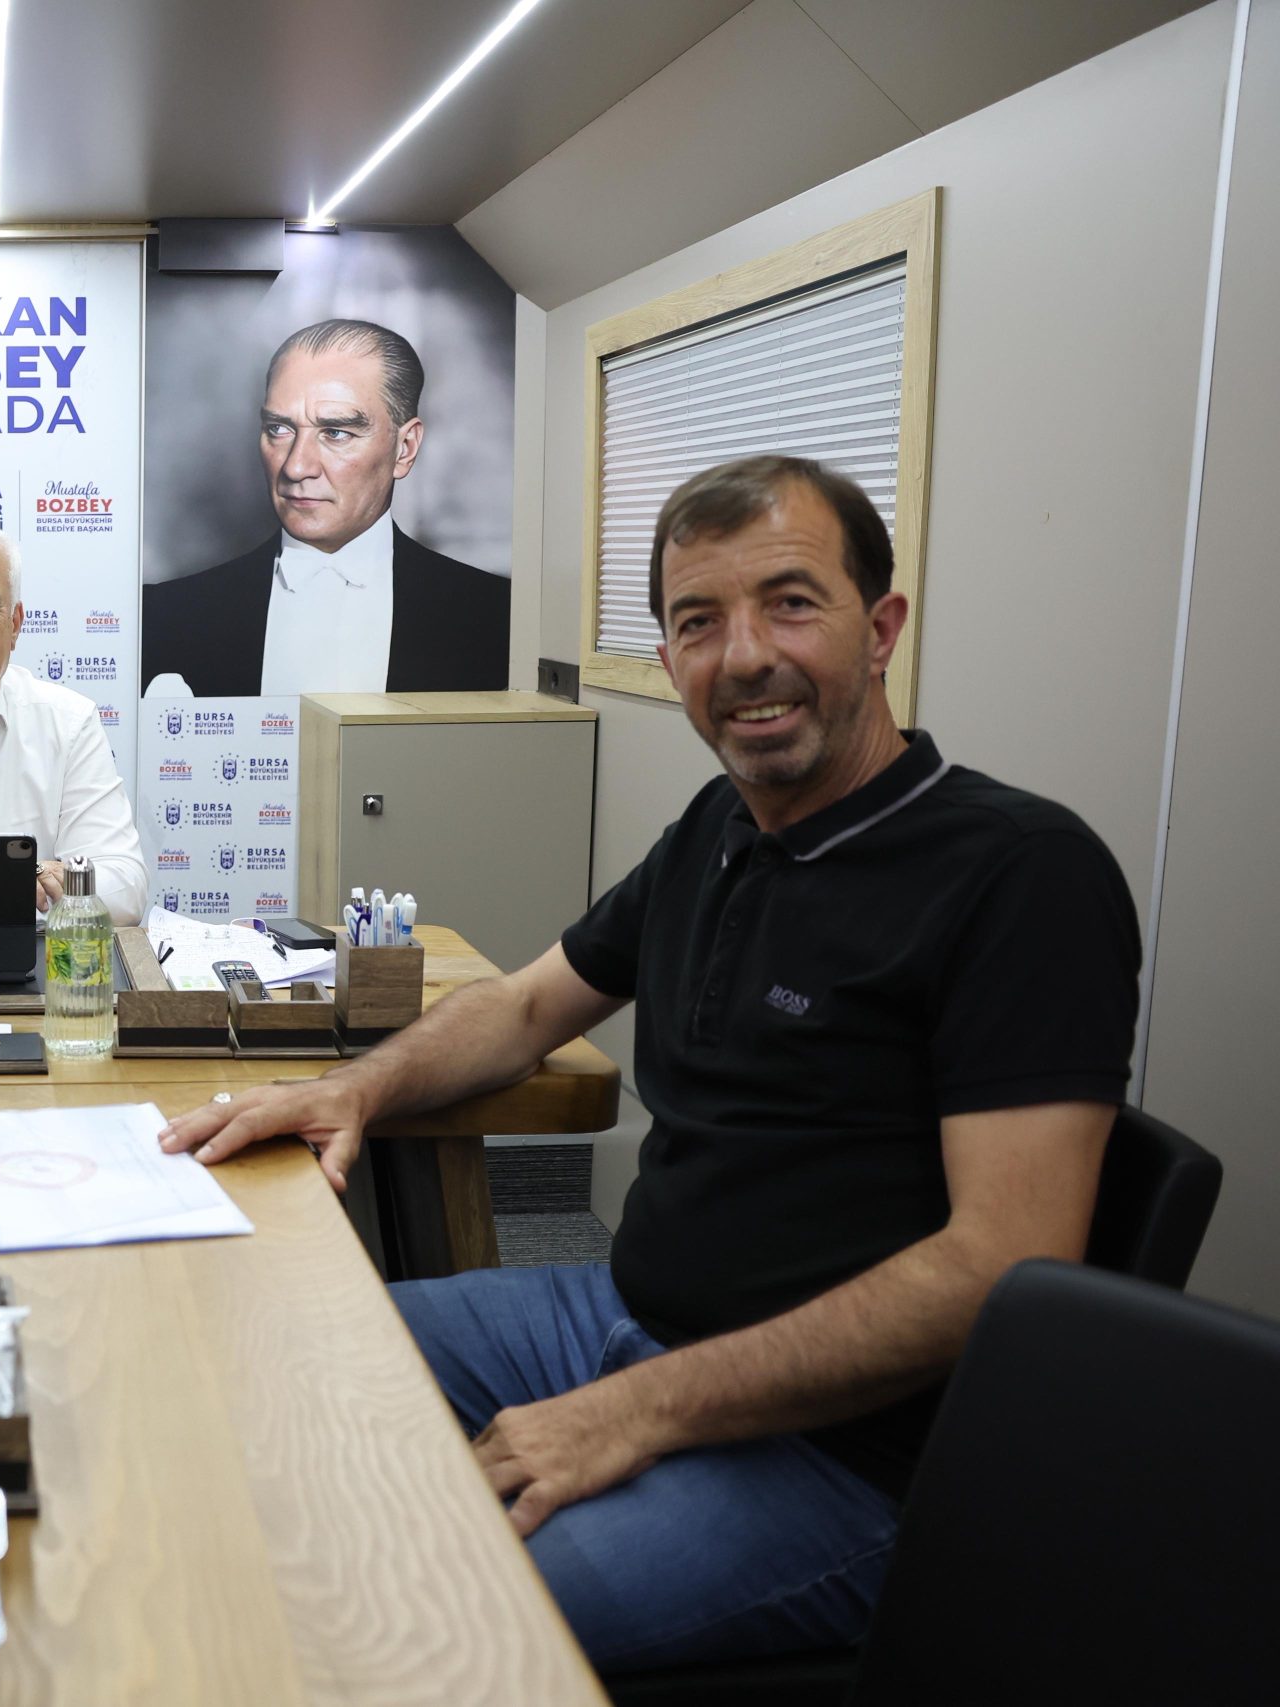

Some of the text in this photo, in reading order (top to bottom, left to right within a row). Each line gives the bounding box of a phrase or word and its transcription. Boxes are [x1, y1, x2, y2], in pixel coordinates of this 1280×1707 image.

[45, 481, 100, 499] Mustafa
[37, 499, 113, 513] BOZBEY
[26, 610, 58, 618] URSA
[76, 658, 116, 666] BURSA
[195, 713, 234, 721] BURSA
[249, 758, 289, 767] BURSA
[193, 803, 232, 812] BURSA
[247, 848, 286, 857] BURSA
[191, 892, 230, 900] BURSA
[768, 984, 812, 1009] BOSS
